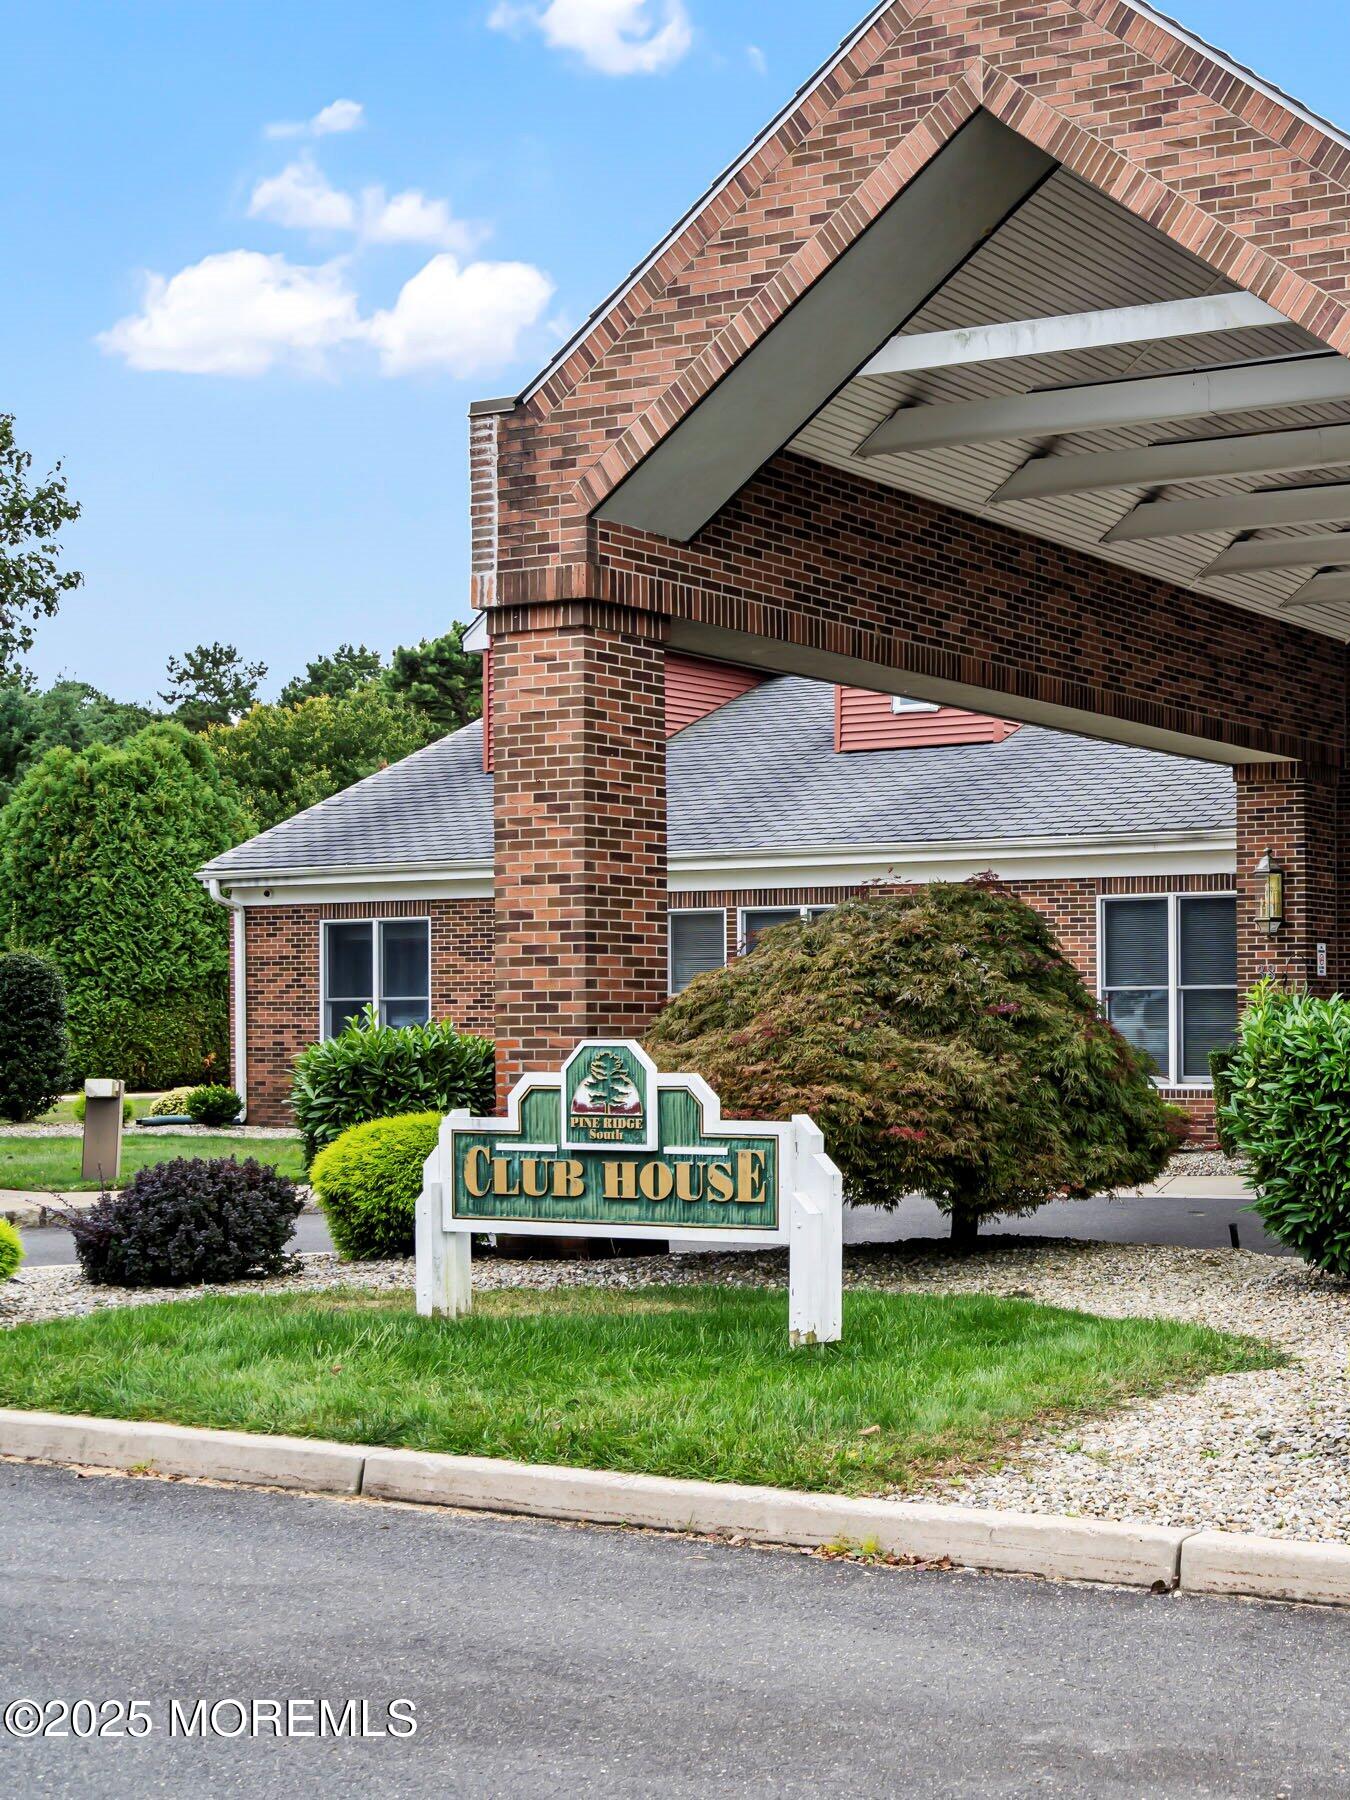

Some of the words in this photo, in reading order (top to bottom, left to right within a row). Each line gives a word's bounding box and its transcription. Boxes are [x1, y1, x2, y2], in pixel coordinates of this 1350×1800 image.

[570, 1116, 600, 1128] PINE
[603, 1117, 643, 1129] RIDGE
[589, 1128, 624, 1140] South
[463, 1146, 585, 1198] CLUB
[602, 1149, 767, 1204] HOUSE
